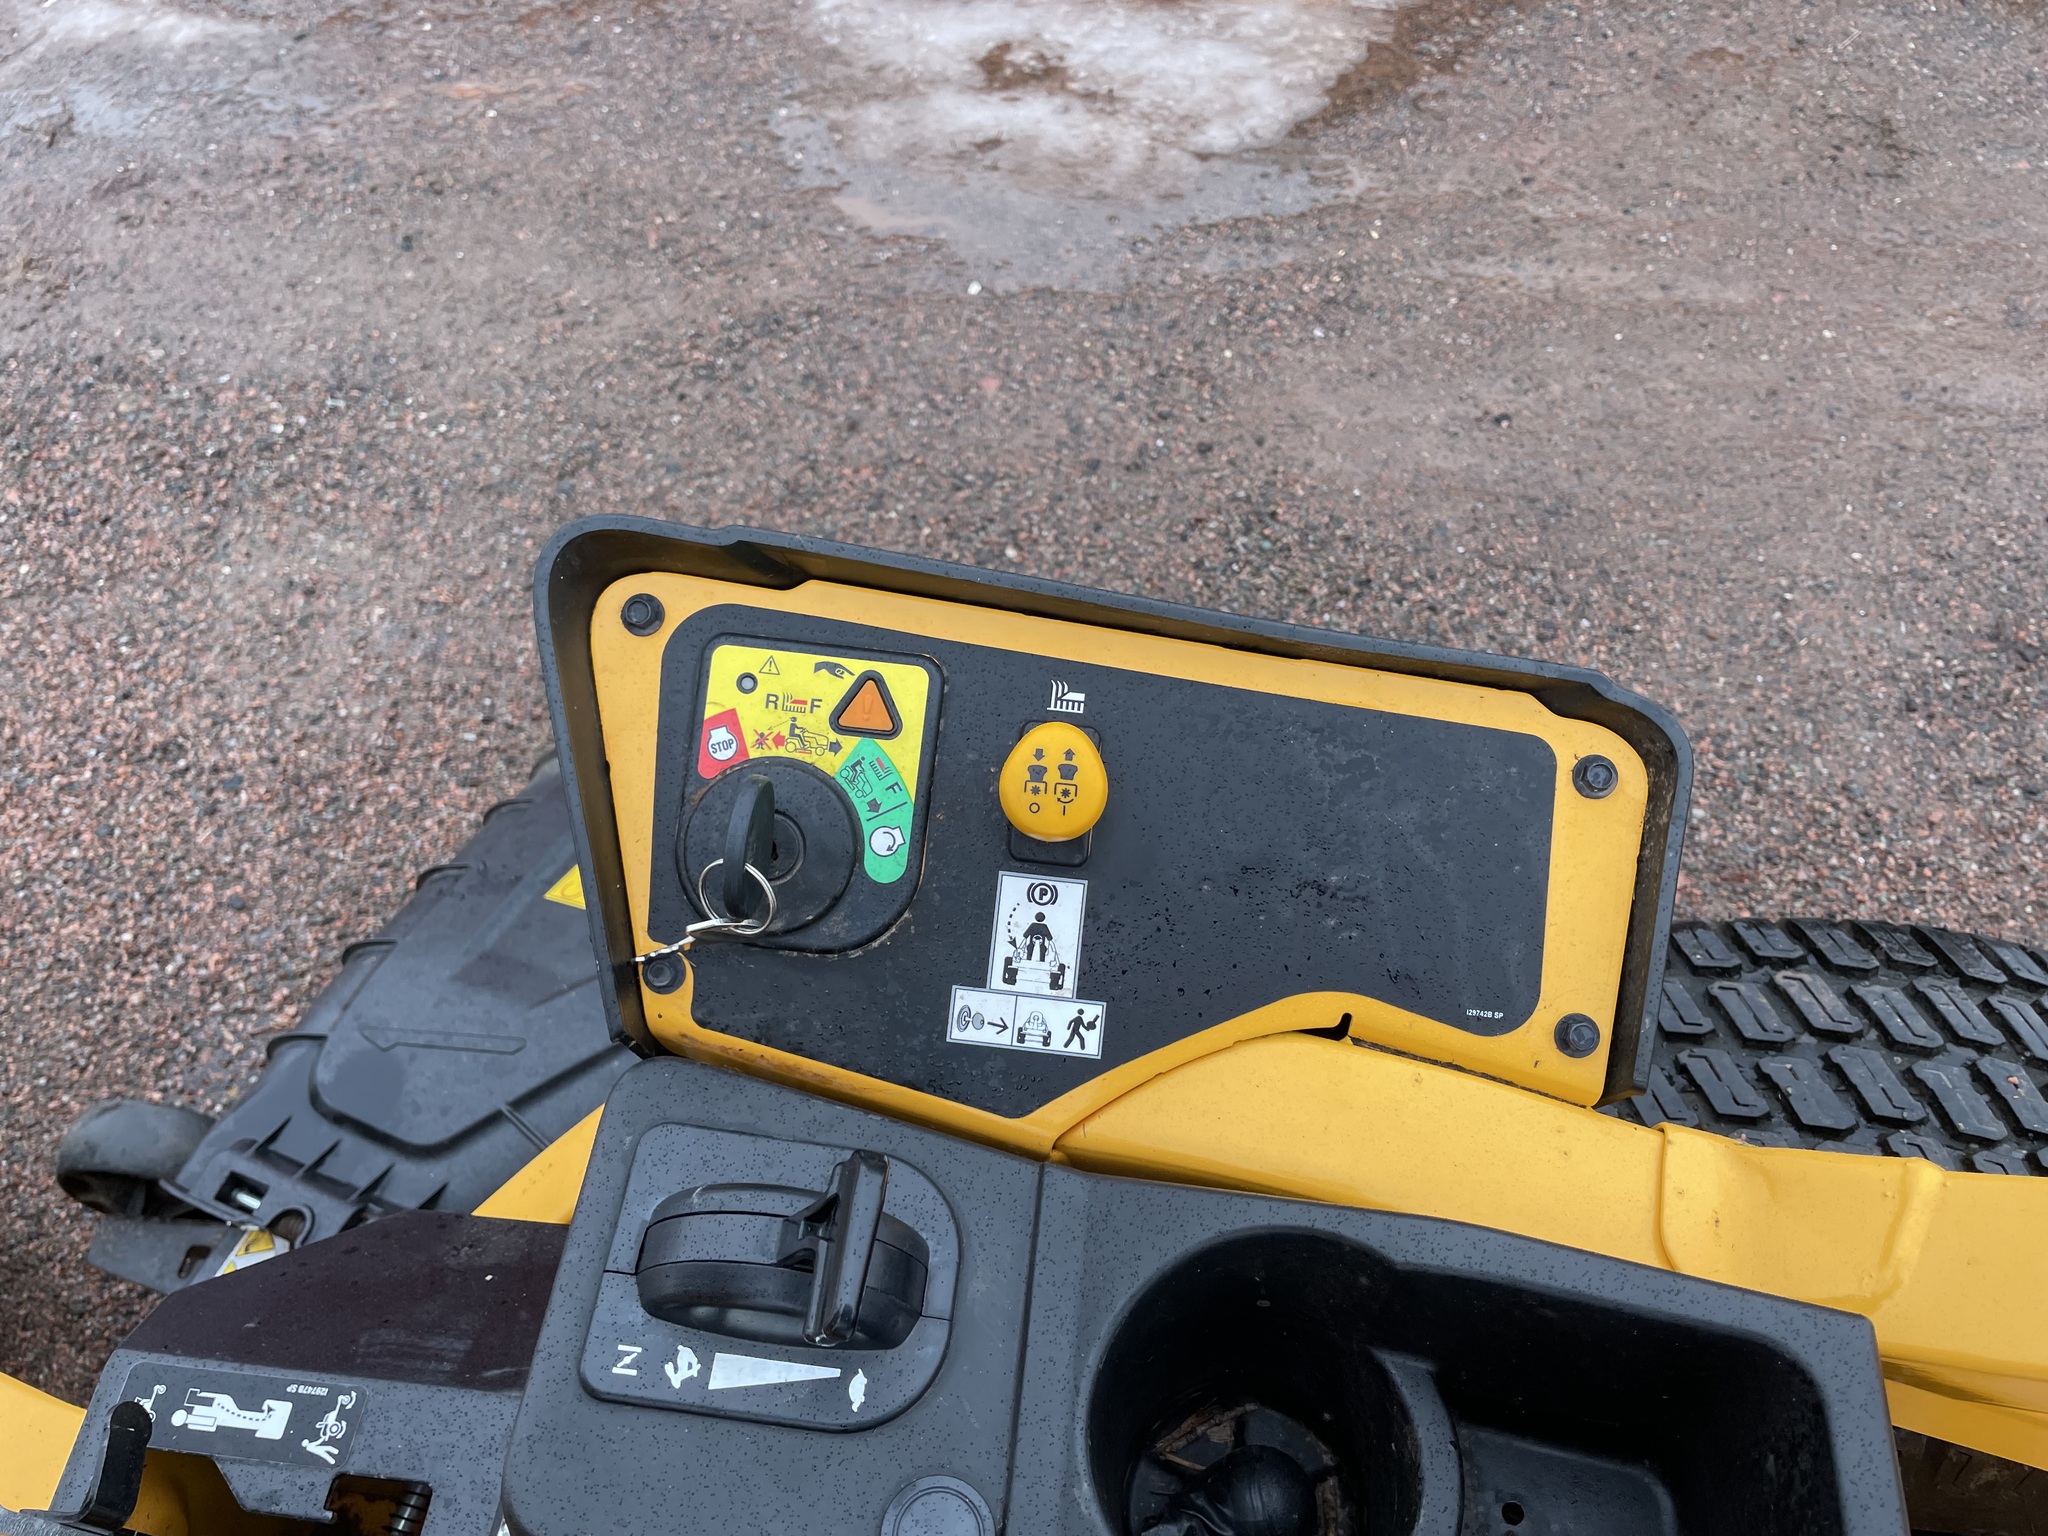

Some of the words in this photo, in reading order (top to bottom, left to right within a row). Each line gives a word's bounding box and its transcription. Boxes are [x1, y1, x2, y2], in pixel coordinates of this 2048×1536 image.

[765, 693, 779, 710] R
[809, 698, 823, 714] F
[710, 738, 734, 754] STOP
[1494, 1011, 1504, 1019] SP
[286, 1384, 298, 1393] SP
